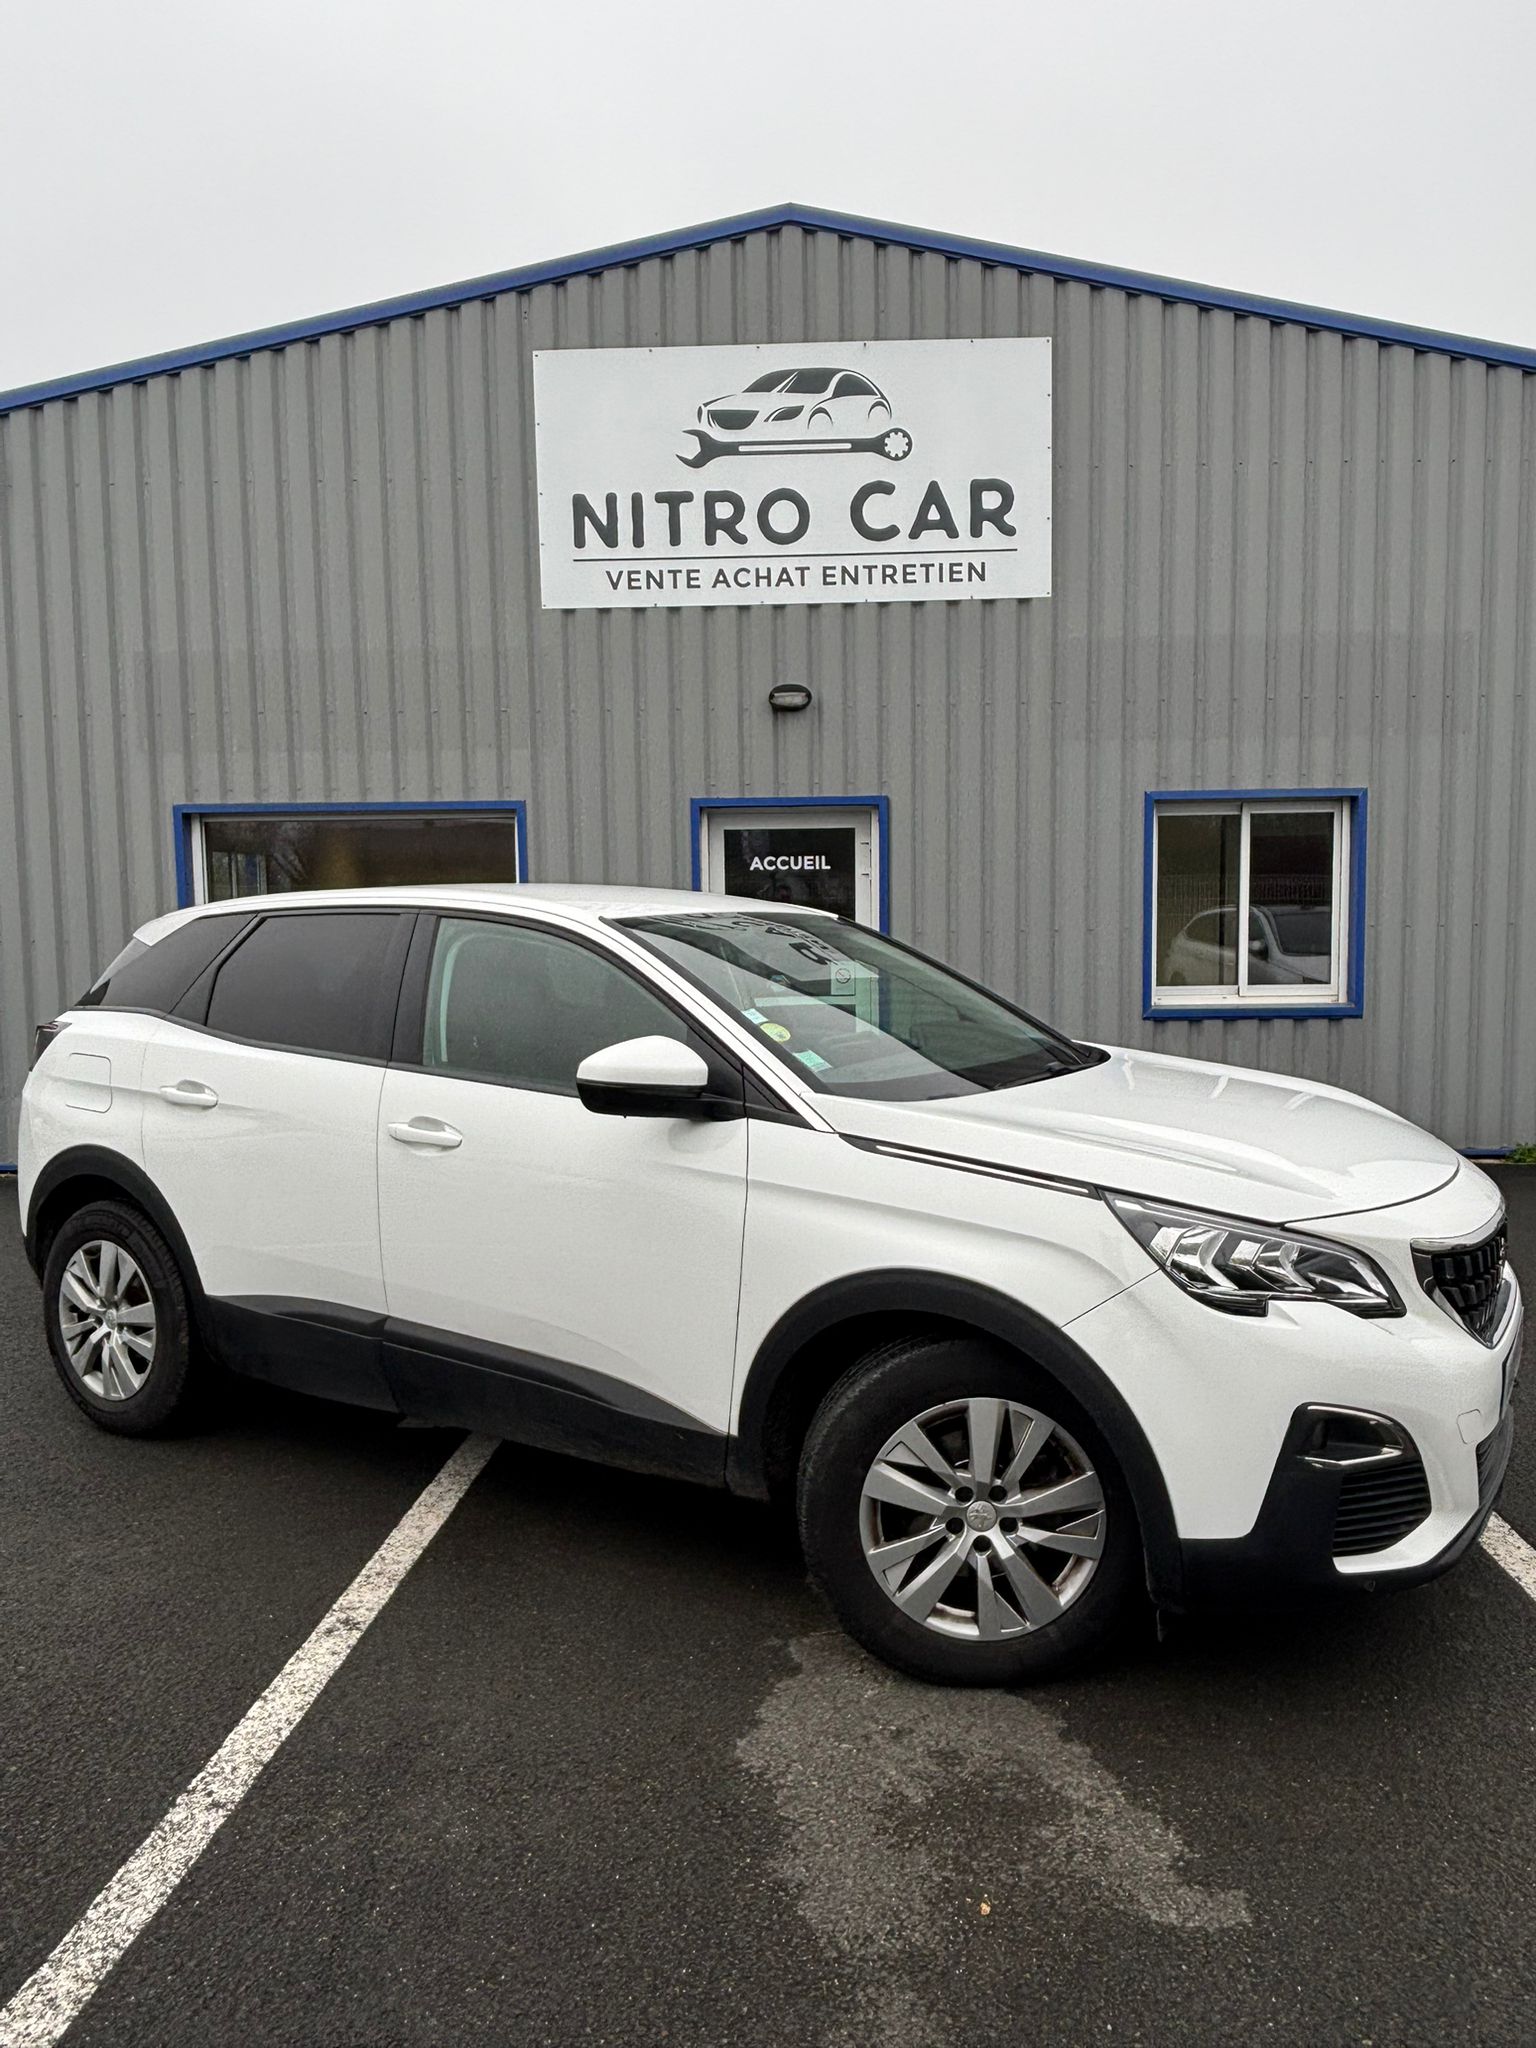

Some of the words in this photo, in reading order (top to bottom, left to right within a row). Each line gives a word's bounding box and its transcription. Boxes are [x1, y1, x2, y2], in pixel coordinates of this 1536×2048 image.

[572, 488, 811, 550] NITRO
[849, 478, 1017, 541] CAR
[606, 569, 702, 591] VENTE
[711, 566, 811, 589] ACHAT
[822, 561, 986, 586] ENTRETIEN
[749, 855, 831, 871] ACCUEIL
